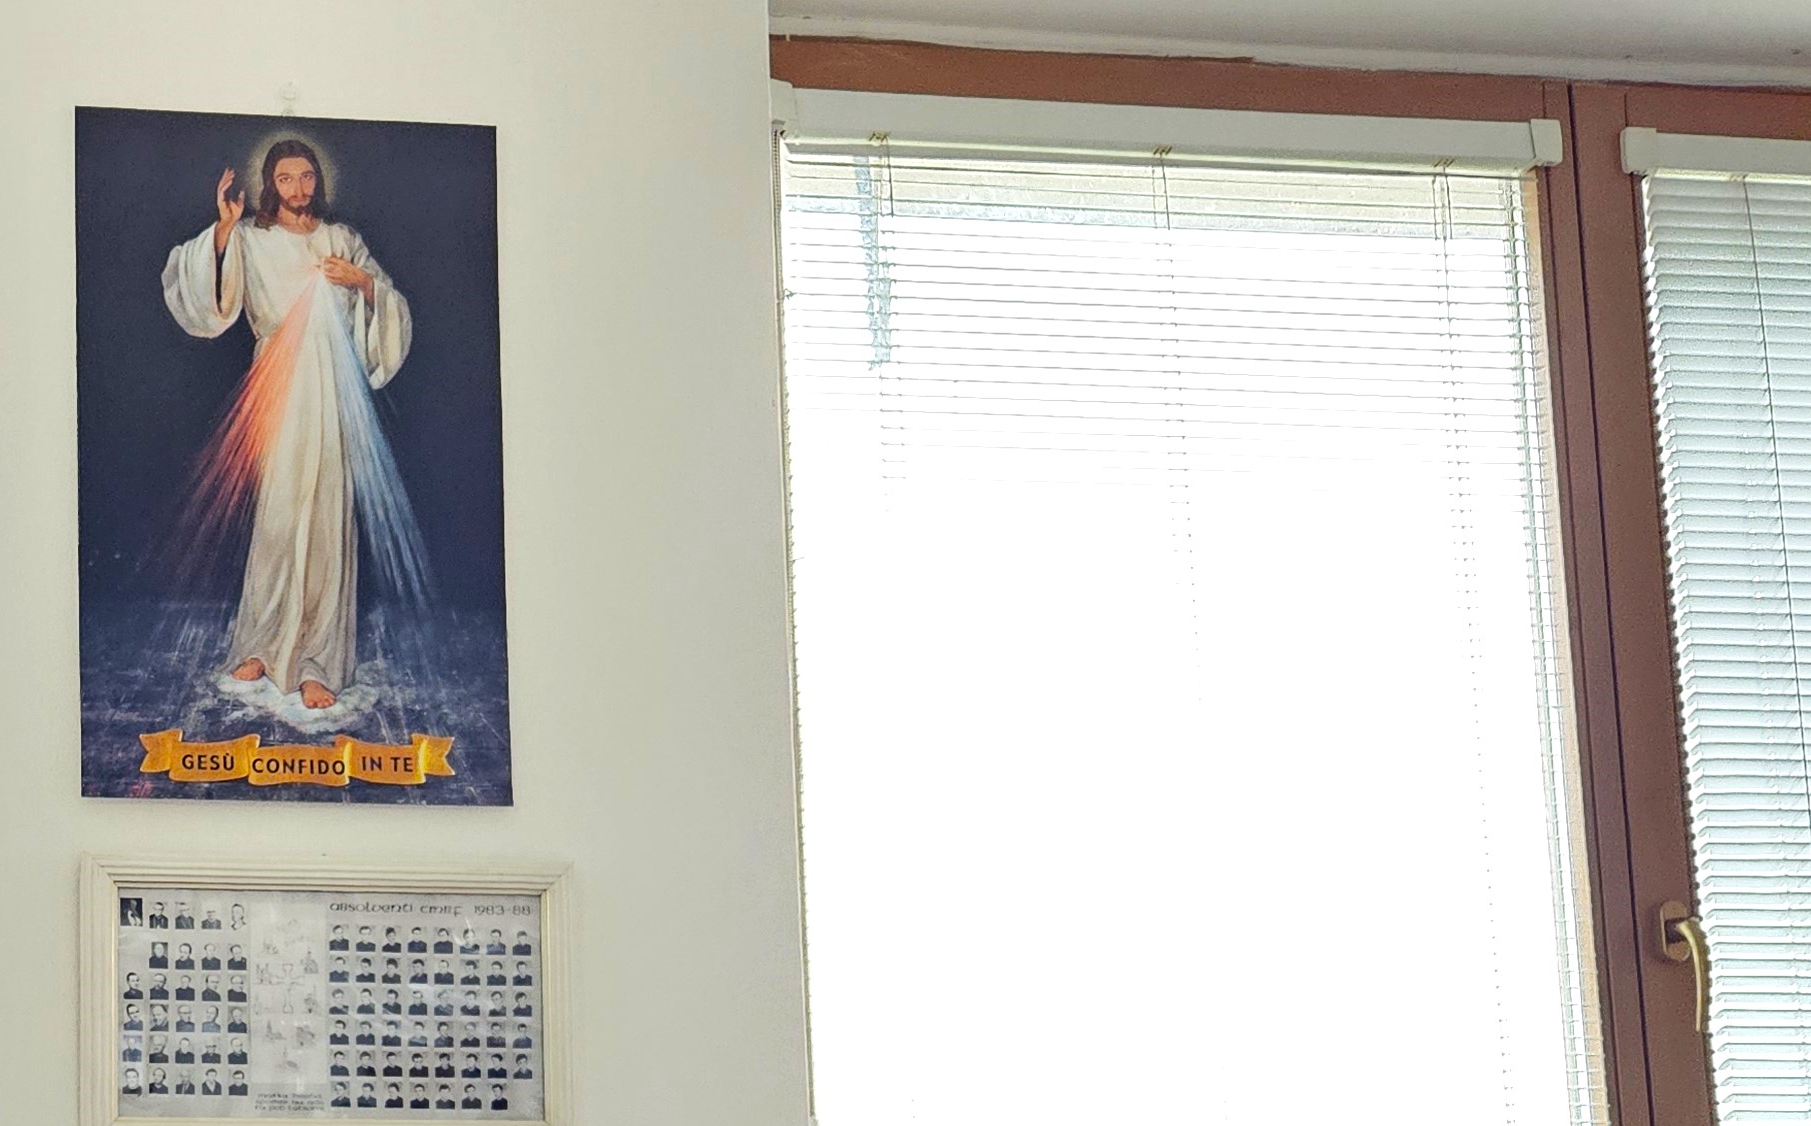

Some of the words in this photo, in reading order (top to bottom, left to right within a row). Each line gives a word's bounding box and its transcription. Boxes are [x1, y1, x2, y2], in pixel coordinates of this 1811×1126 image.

[181, 752, 235, 772] GESÙ
[251, 757, 347, 775] CONFIDO
[361, 755, 383, 772] IN
[390, 756, 414, 773] TE
[474, 904, 532, 916] 1983-88
